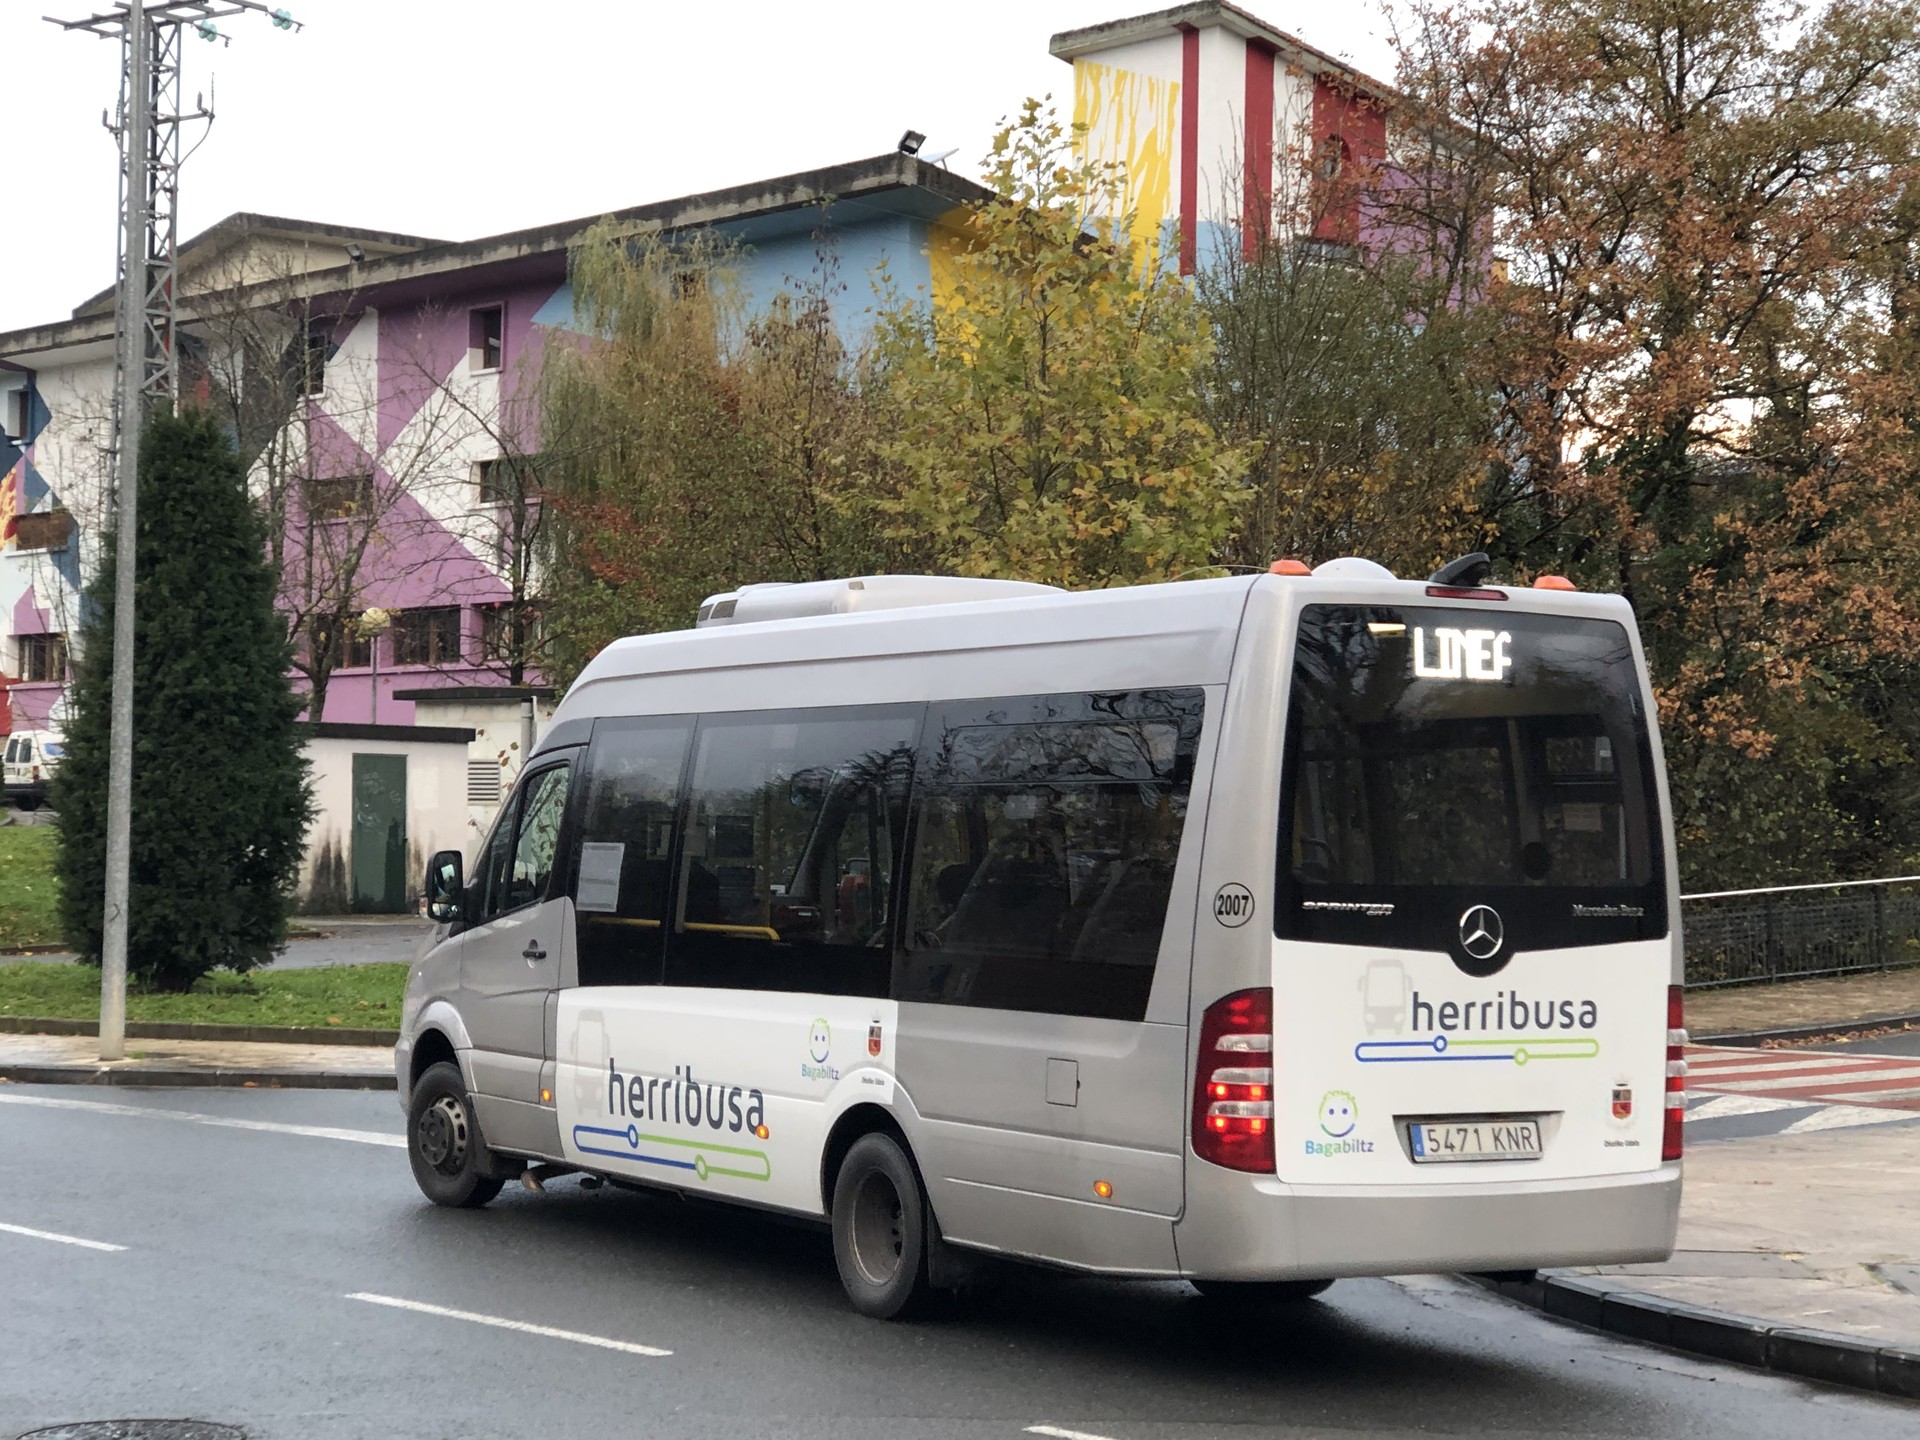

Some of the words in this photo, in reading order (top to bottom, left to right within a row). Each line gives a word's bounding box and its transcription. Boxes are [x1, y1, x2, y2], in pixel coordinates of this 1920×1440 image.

[1217, 894, 1249, 916] 2007
[1412, 990, 1598, 1031] herribusa
[801, 1063, 840, 1081] Bagabiltz
[608, 1057, 766, 1136] herribusa
[1305, 1139, 1375, 1158] Bagabiltz
[1427, 1127, 1482, 1153] 5471
[1491, 1126, 1534, 1151] KNR
